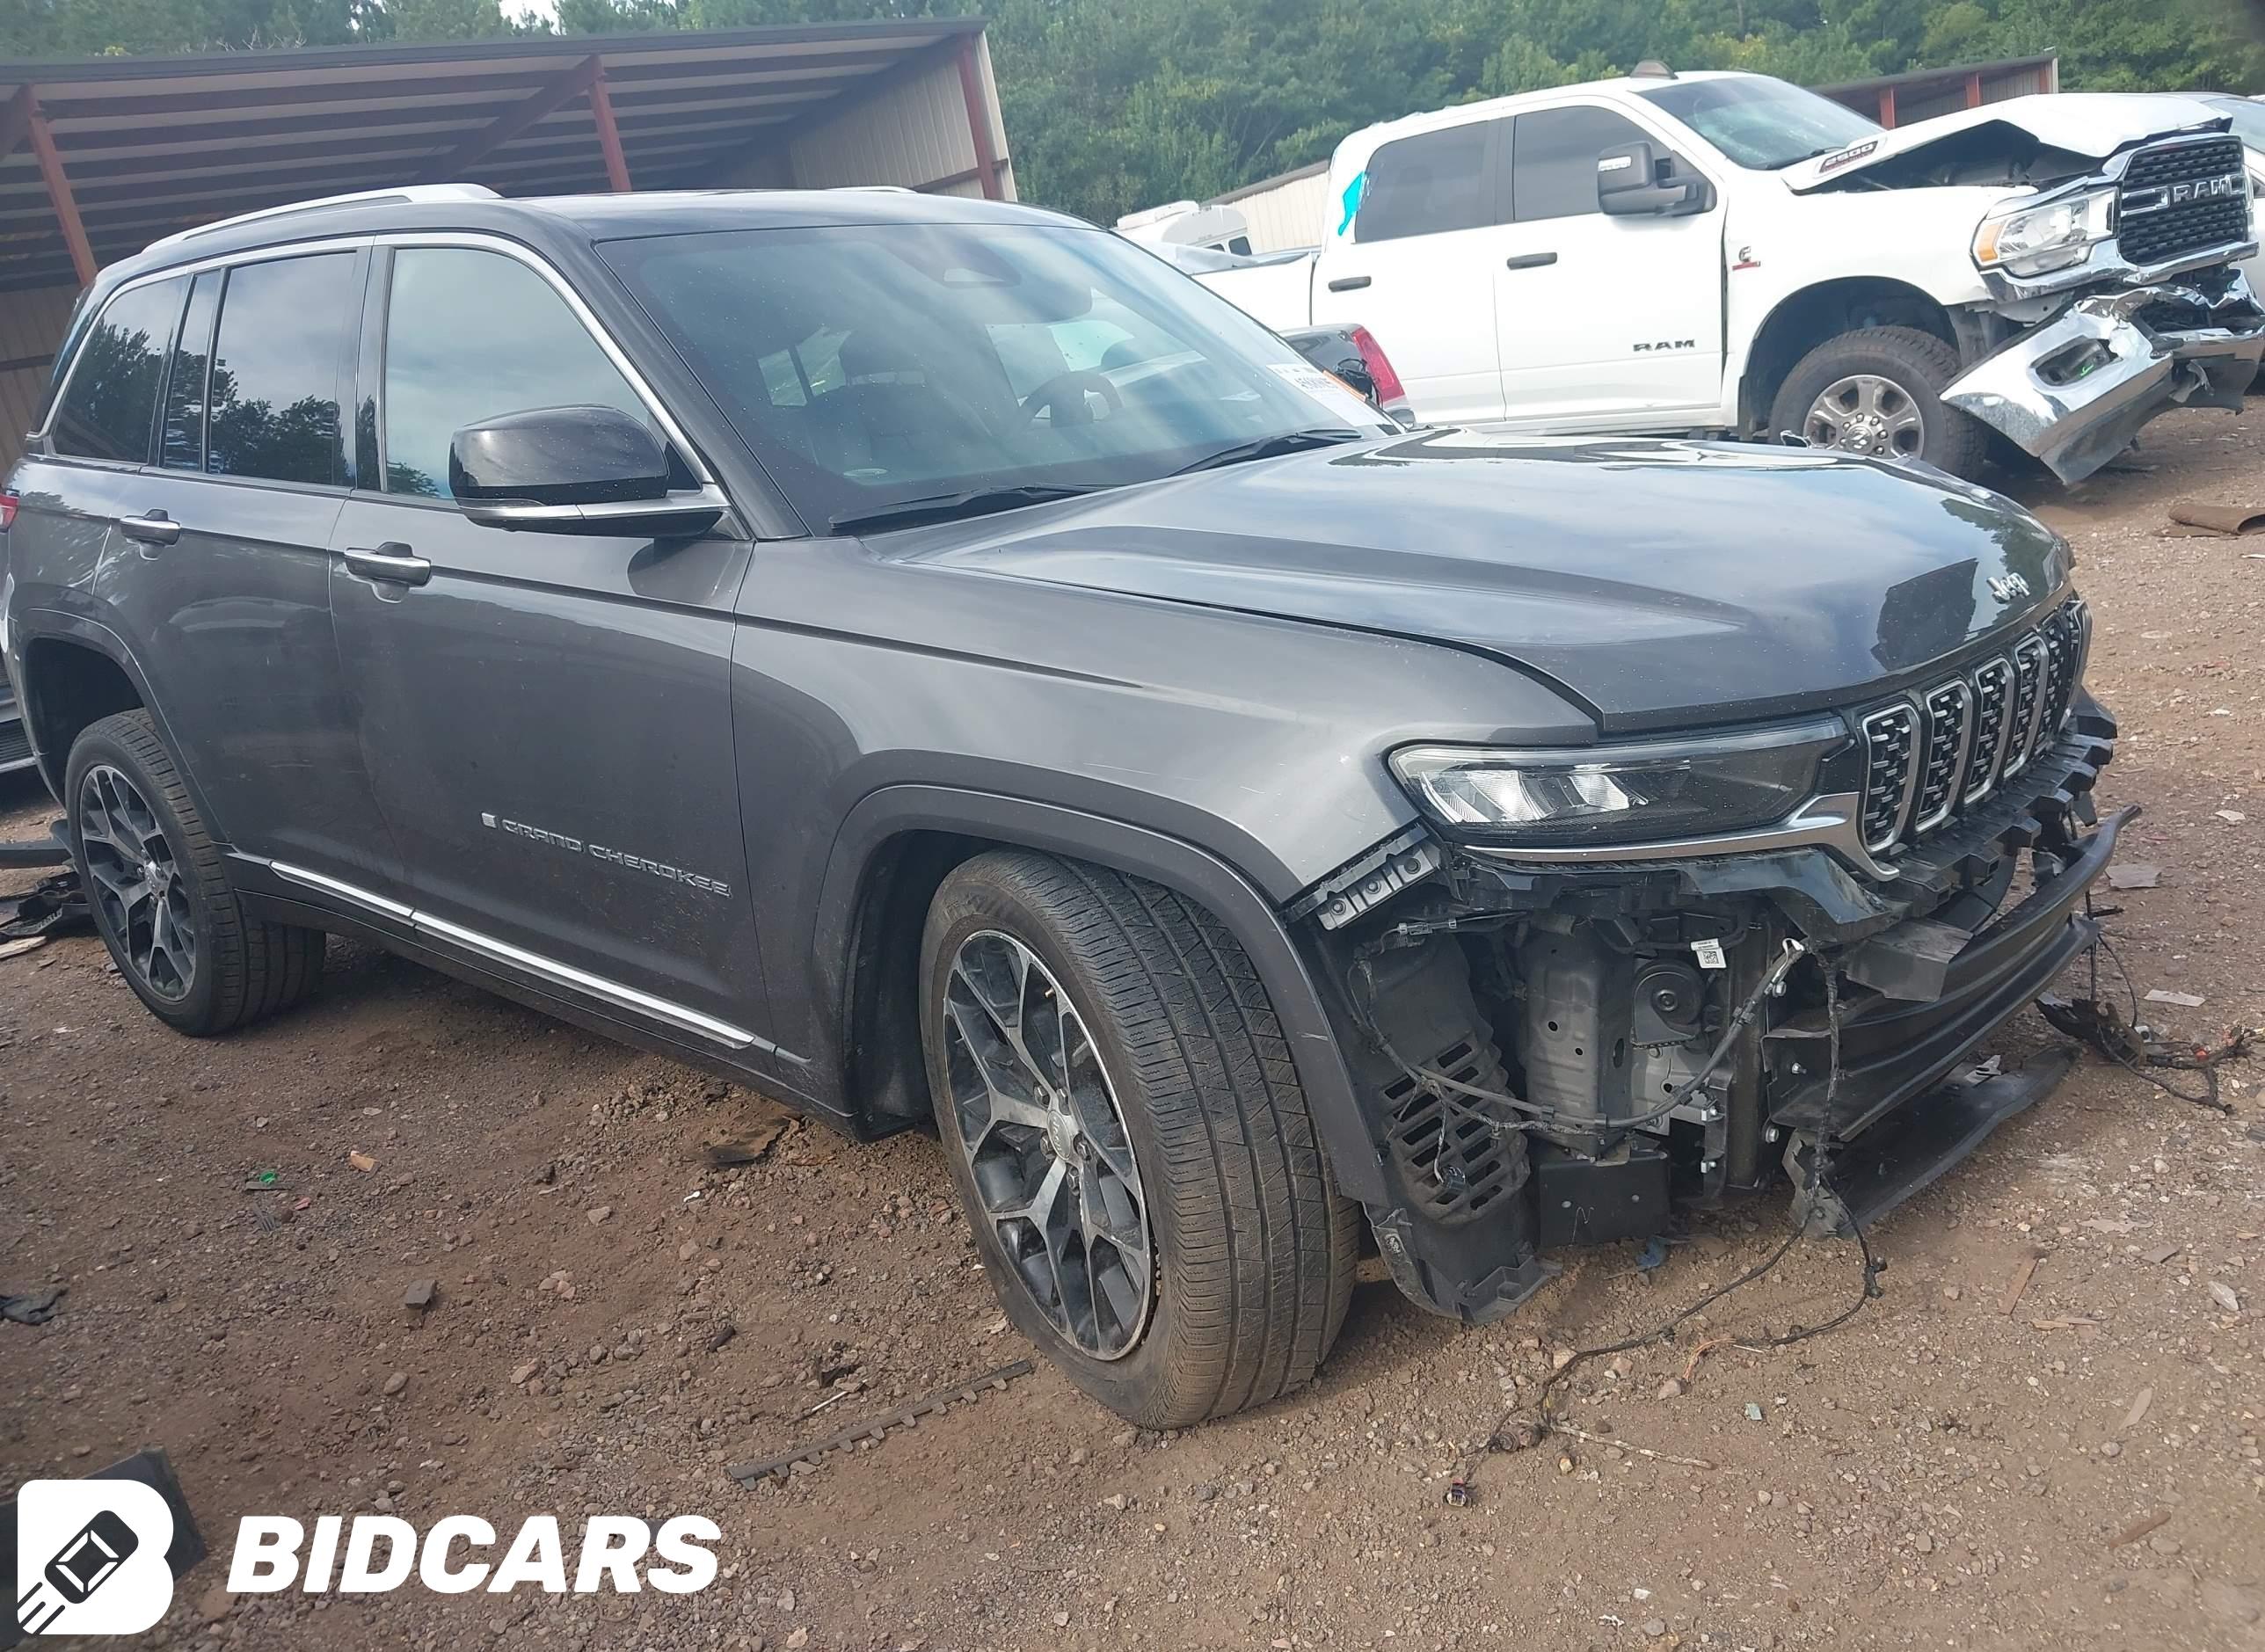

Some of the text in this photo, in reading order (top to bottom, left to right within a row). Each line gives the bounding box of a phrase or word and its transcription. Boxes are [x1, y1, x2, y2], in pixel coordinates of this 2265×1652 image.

[2173, 178, 2230, 203] RAM
[1633, 339, 1695, 353] RAM
[501, 819, 732, 898] GRAND CHEROKEE
